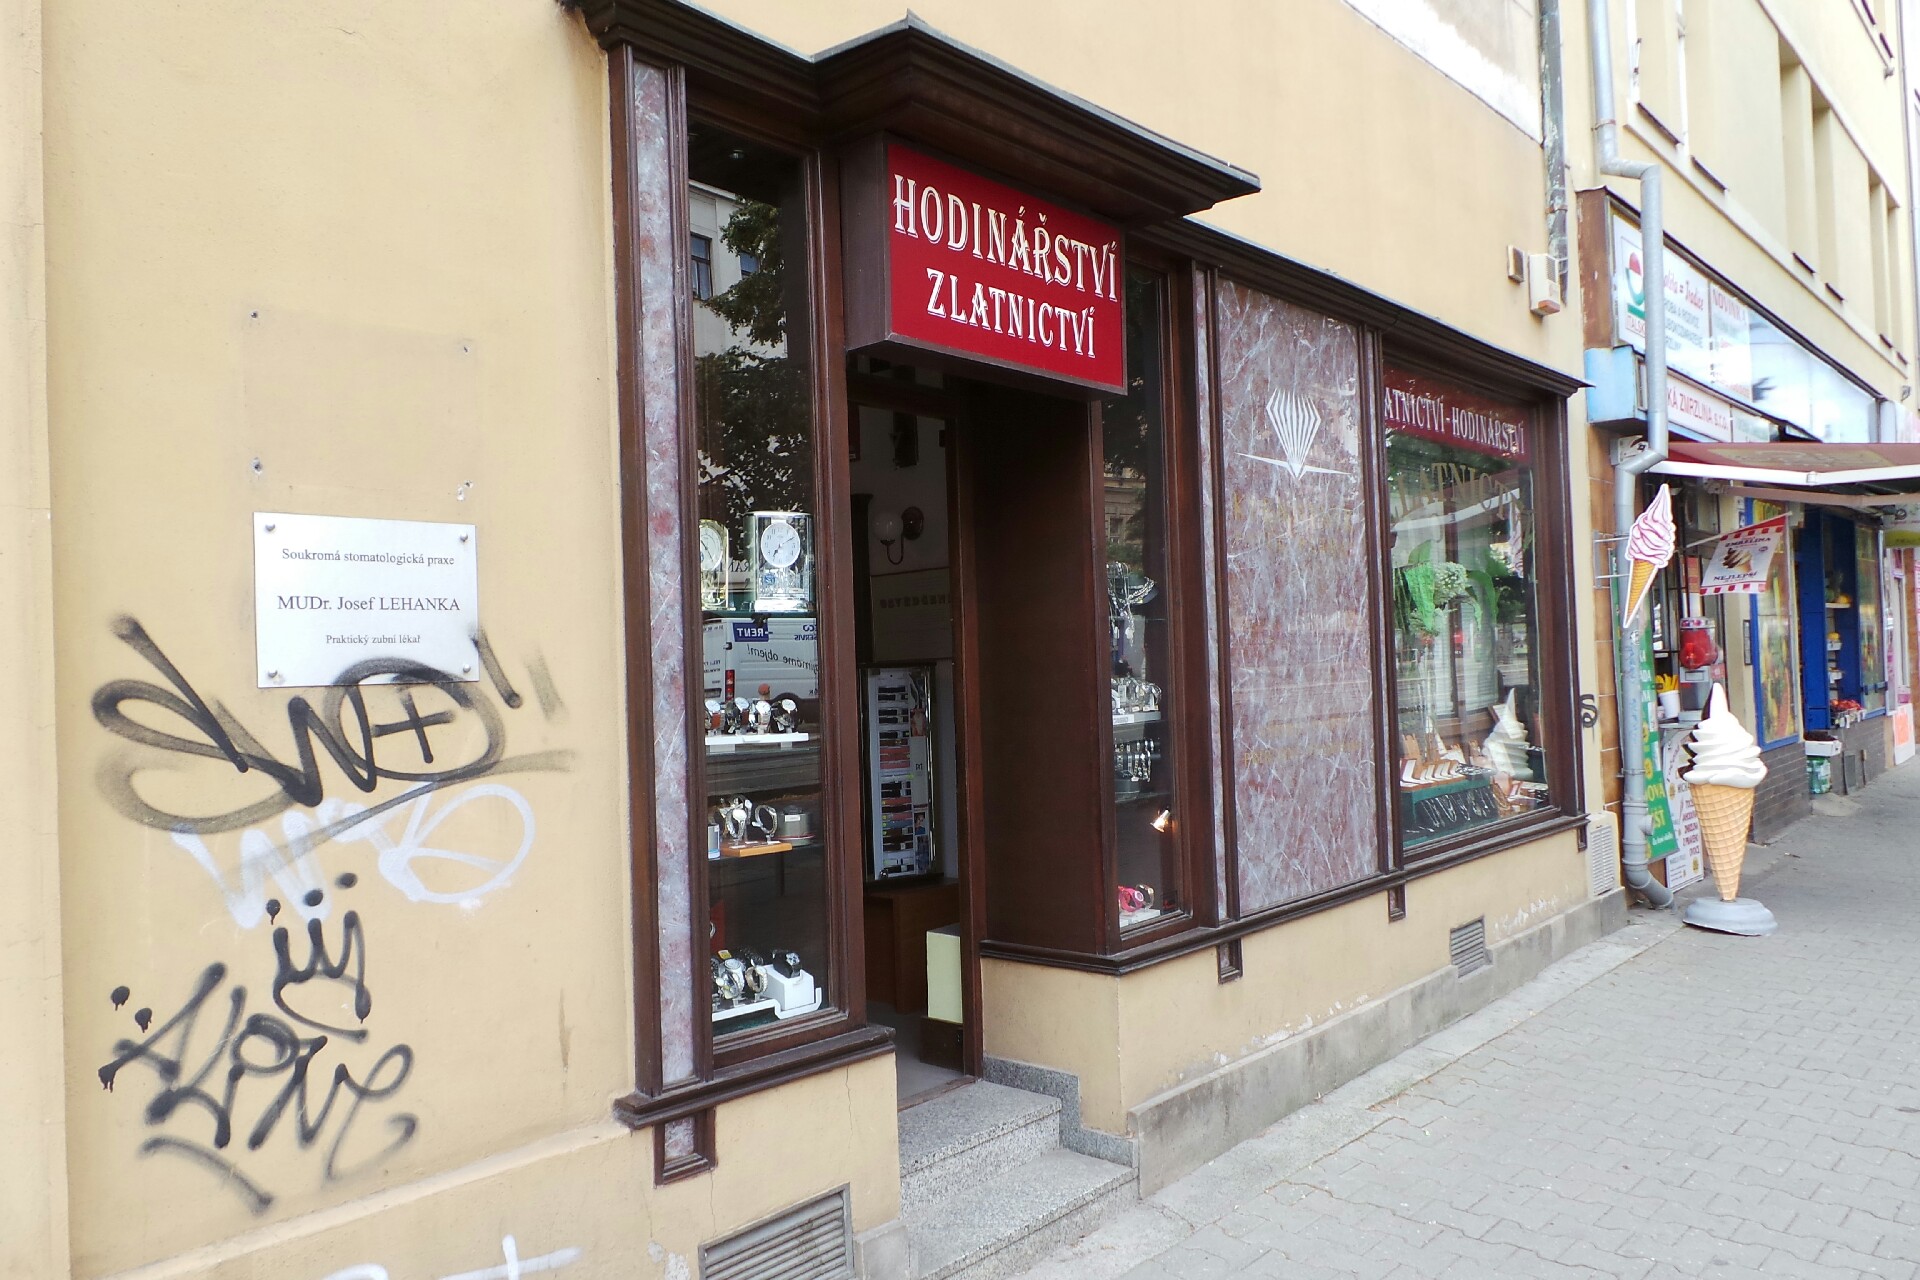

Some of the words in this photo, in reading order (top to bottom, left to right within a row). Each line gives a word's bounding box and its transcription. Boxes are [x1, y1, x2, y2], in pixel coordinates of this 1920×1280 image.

[893, 173, 1118, 303] HODINÁŘSTVÍ
[926, 267, 1096, 359] ZLATNICTVÍ
[1384, 386, 1445, 433] ATNICTVÍ
[281, 548, 341, 562] Soukromá
[343, 552, 425, 566] stomatologická
[427, 555, 455, 567] praxe
[277, 595, 332, 611] MUDr.
[337, 596, 376, 611] Josef
[378, 597, 461, 611] LEHANKA
[326, 634, 369, 646] Praktický
[372, 635, 396, 644] zubní
[399, 635, 421, 644] lékař
